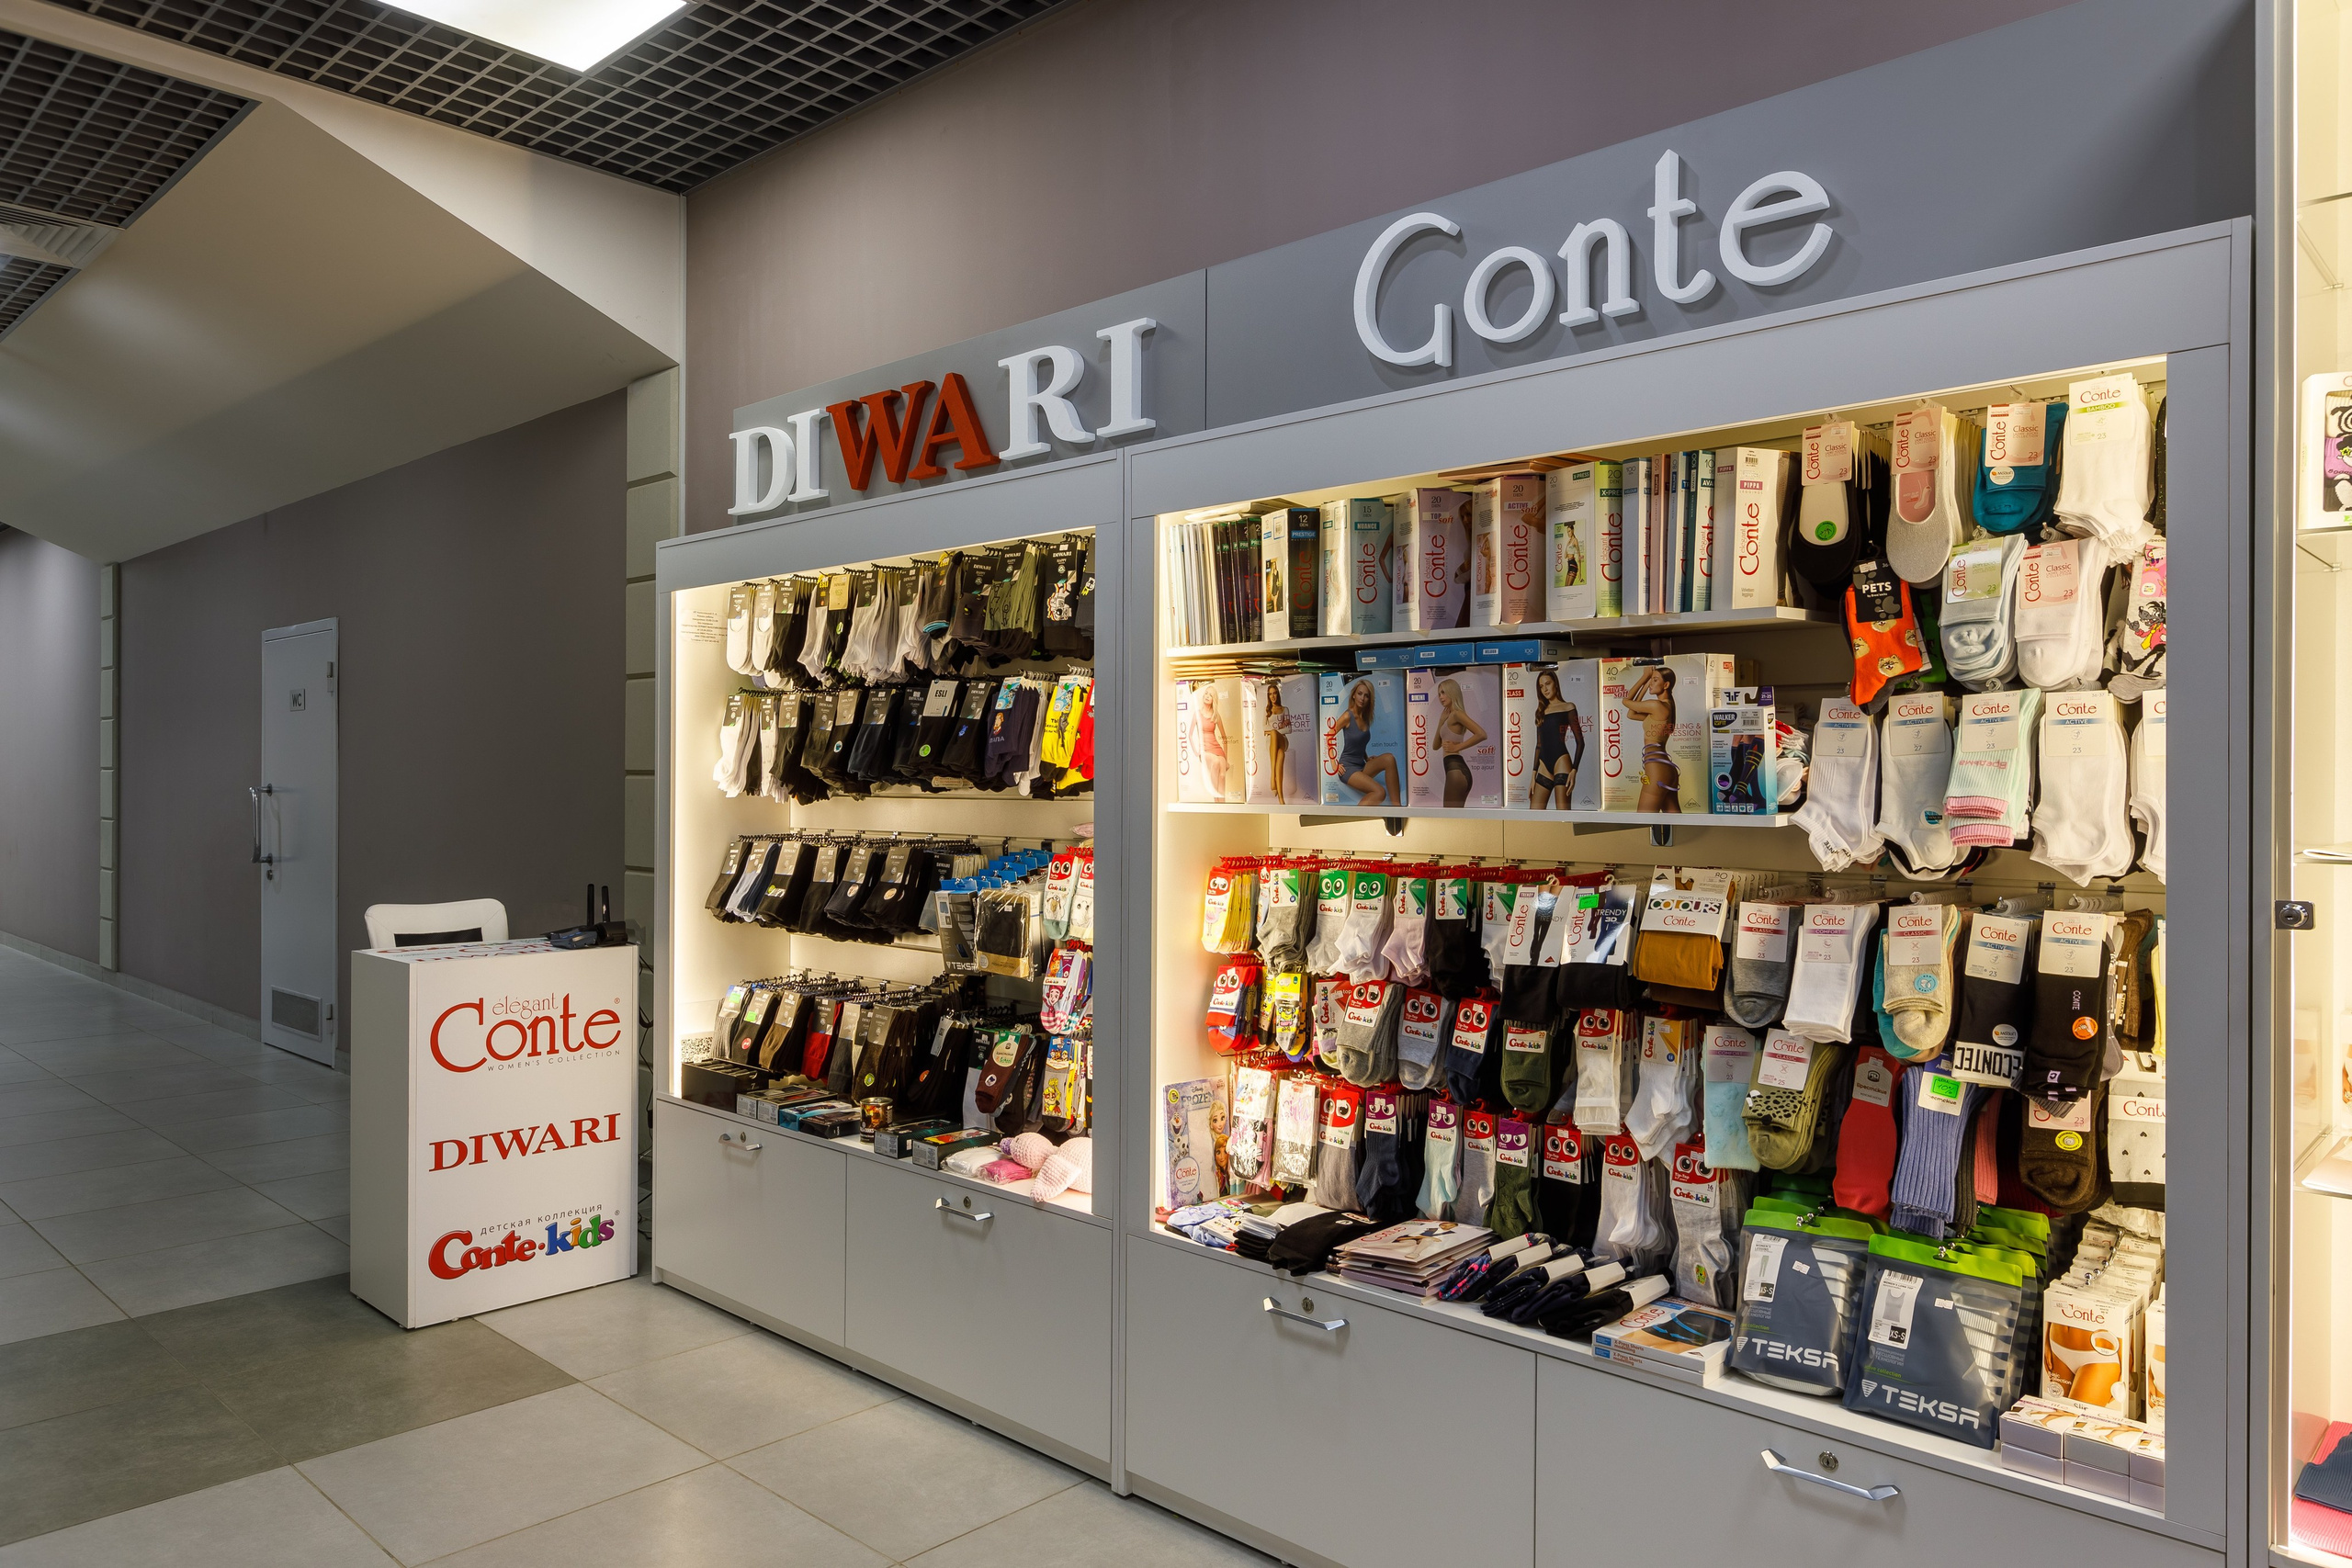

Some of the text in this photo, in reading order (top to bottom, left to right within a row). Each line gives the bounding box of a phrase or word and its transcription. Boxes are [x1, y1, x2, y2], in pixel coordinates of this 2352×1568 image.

[1352, 148, 1835, 369] Conte
[2080, 389, 2121, 403] Conte
[2086, 403, 2115, 412] BAMBOO
[727, 317, 1158, 516] DIWARI
[1915, 430, 1936, 438] Classic
[1990, 421, 2006, 460] Conte
[1825, 443, 1847, 452] Classic
[1896, 428, 1910, 468] Conte
[1806, 442, 1821, 479] Conte
[1608, 469, 1622, 479] 20
[1521, 504, 1537, 513] soft
[1438, 515, 1453, 524] soft
[1739, 502, 1759, 576] Conte
[1600, 512, 1623, 582] Conte
[1507, 525, 1530, 591] Conte
[1425, 534, 1447, 598] Conte
[2046, 563, 2072, 572] Classic
[1294, 551, 1313, 609] Conte
[1357, 543, 1377, 604] Conte
[1952, 559, 1966, 597] Conte
[1862, 581, 1892, 593] PETS
[2025, 562, 2041, 602] Conte
[1508, 672, 1518, 681] 20
[1606, 666, 1618, 676] 40
[292, 694, 301, 706] WC
[1613, 690, 1628, 698] soft
[1828, 708, 1860, 719] Conte
[1898, 705, 1933, 717] Conte
[1973, 704, 2010, 716] Conte
[2057, 704, 2097, 716] Conte
[1577, 716, 1592, 724] SILK
[1179, 722, 1190, 776] Conte
[1324, 716, 1339, 776] Conte
[1411, 715, 1429, 777] Conte
[1507, 712, 1523, 777] Conte
[1604, 708, 1623, 778] Conte
[1476, 746, 1496, 755] soft
[1650, 899, 1719, 914] COLOURS
[1510, 904, 1529, 947] Conte
[1663, 915, 1696, 927] Conte
[1747, 912, 1780, 926] Conte
[1813, 915, 1845, 927] Conte
[1898, 916, 1932, 928] Conte
[1567, 908, 1586, 946] Conte
[1981, 926, 2017, 942] Conte
[2052, 922, 2092, 935] Conte
[2073, 990, 2081, 1010] CONTE
[430, 992, 622, 1073] Conte
[1714, 1036, 1746, 1047] Conte
[1773, 1039, 1804, 1054] Conte
[487, 1050, 621, 1072] WOMEN'S COLLECTION
[1776, 1053, 1797, 1061] CLASSIC
[1938, 1084, 1954, 1094] 10%
[1181, 1090, 1215, 1107] FROZEN
[428, 1112, 621, 1172] DIWARI
[1176, 1167, 1196, 1179] Conte
[480, 1203, 603, 1236] детская коллекция
[1620, 1308, 1665, 1328] Conte
[2062, 1304, 2104, 1324] Conte
[1890, 1330, 1905, 1340] XS-S
[1630, 1343, 1644, 1351] Shorts
[1613, 1352, 1628, 1360] X-Press
[1613, 1357, 1634, 1366] modelling
[1751, 1338, 1838, 1371] TEKSA
[1877, 1368, 1902, 1378] collection
[1882, 1384, 1980, 1429] TEKSA
